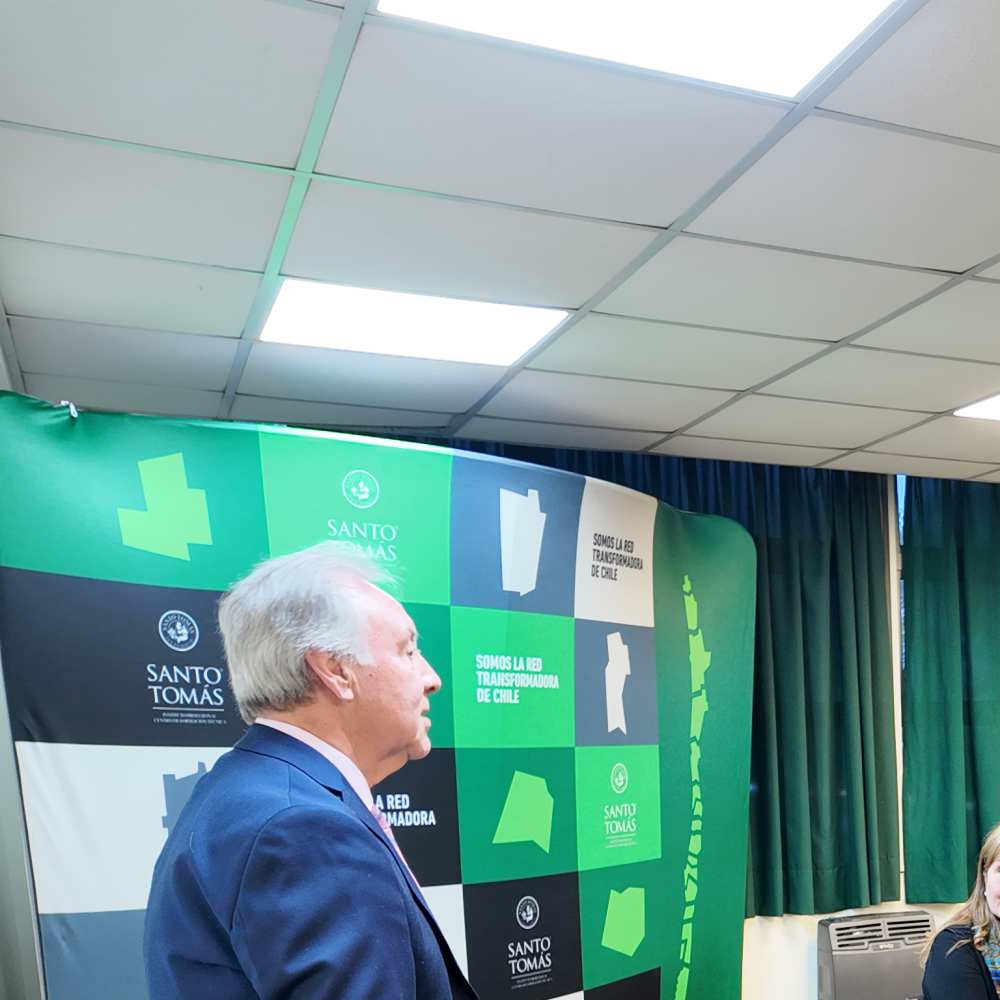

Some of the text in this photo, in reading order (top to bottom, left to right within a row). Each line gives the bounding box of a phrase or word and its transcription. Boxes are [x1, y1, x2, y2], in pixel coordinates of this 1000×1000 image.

[327, 519, 396, 542] SANTO
[593, 533, 634, 553] SOMOS LA RED
[593, 548, 643, 570] TRANSFORMADORA
[591, 564, 618, 581] DE CHILE
[475, 653, 542, 672] SOMOS LA RED
[146, 663, 222, 685] SANTO
[476, 671, 559, 689] TRANSFORMADORA
[148, 683, 224, 706] TOMÁS
[477, 688, 519, 704] DE CHILE
[375, 793, 410, 810] A RED
[604, 803, 637, 818] SANTO
[604, 815, 637, 835] TOMÁS
[508, 936, 551, 958] SANTO
[508, 951, 552, 975] TOMÁS
